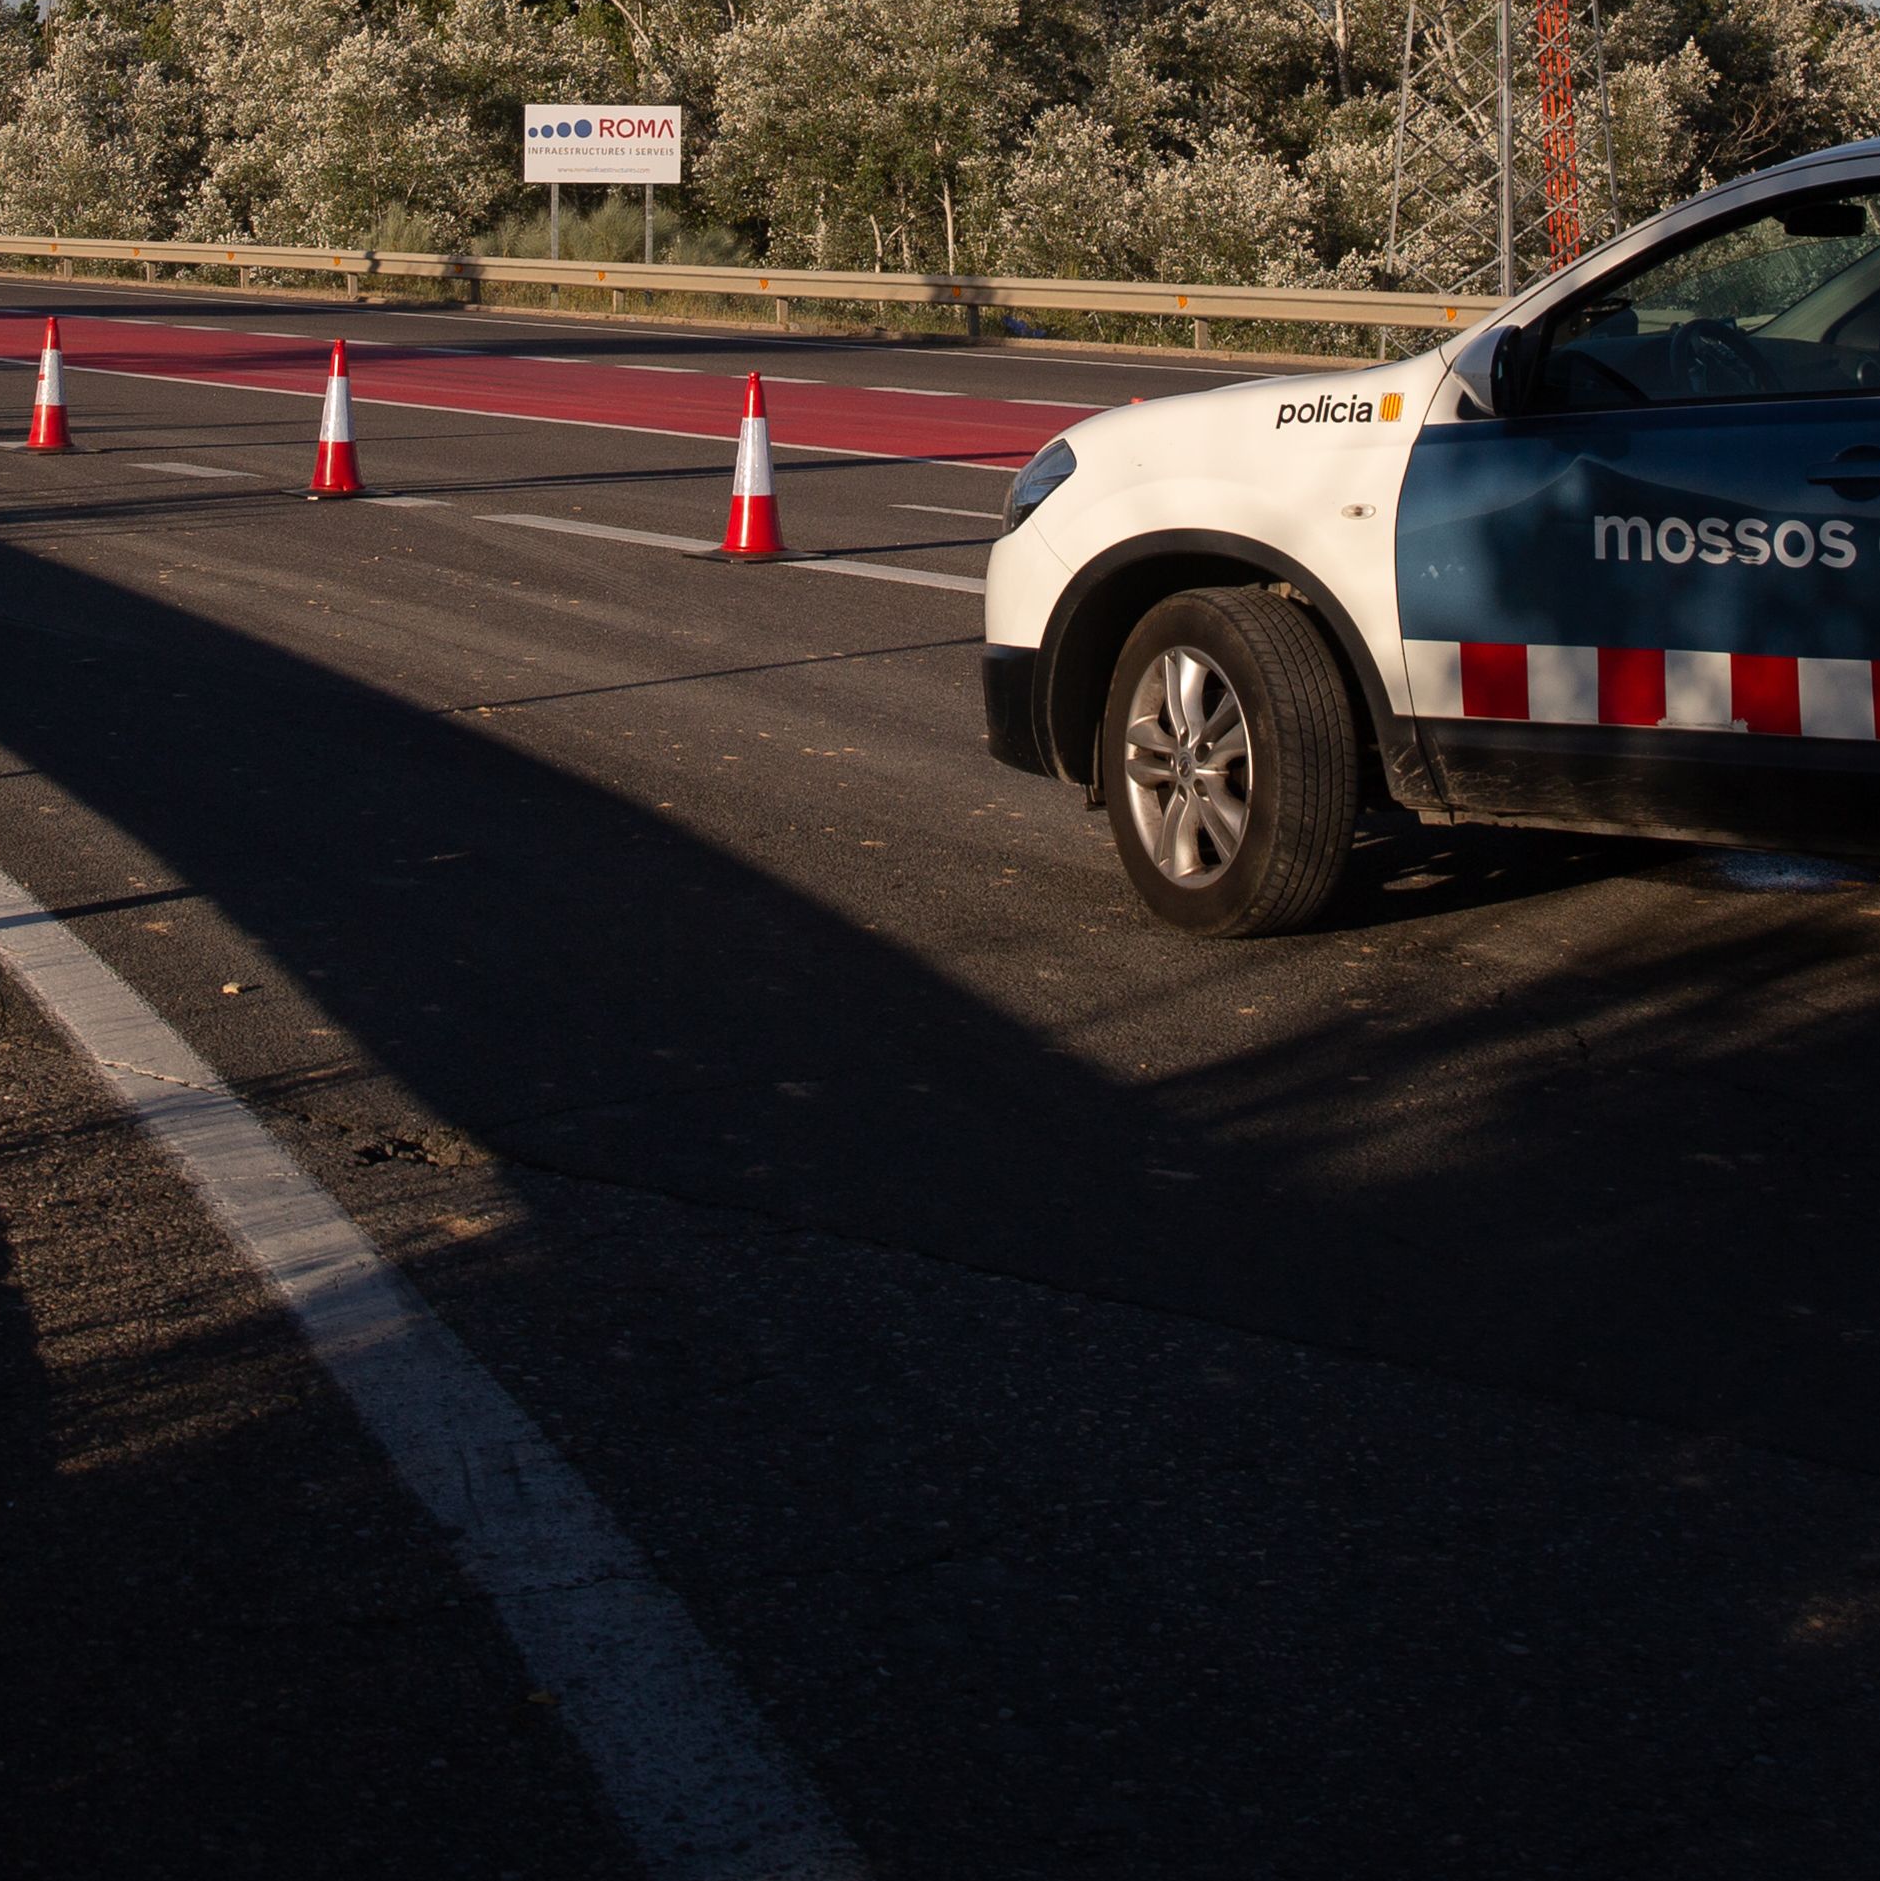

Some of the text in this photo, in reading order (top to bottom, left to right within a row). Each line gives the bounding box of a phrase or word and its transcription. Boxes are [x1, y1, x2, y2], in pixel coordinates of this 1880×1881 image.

[528, 147, 625, 155] INFRAESTRUCTURES
[635, 148, 675, 156] SERVEIS
[1275, 393, 1374, 430] policia
[1593, 514, 1858, 570] mossos
